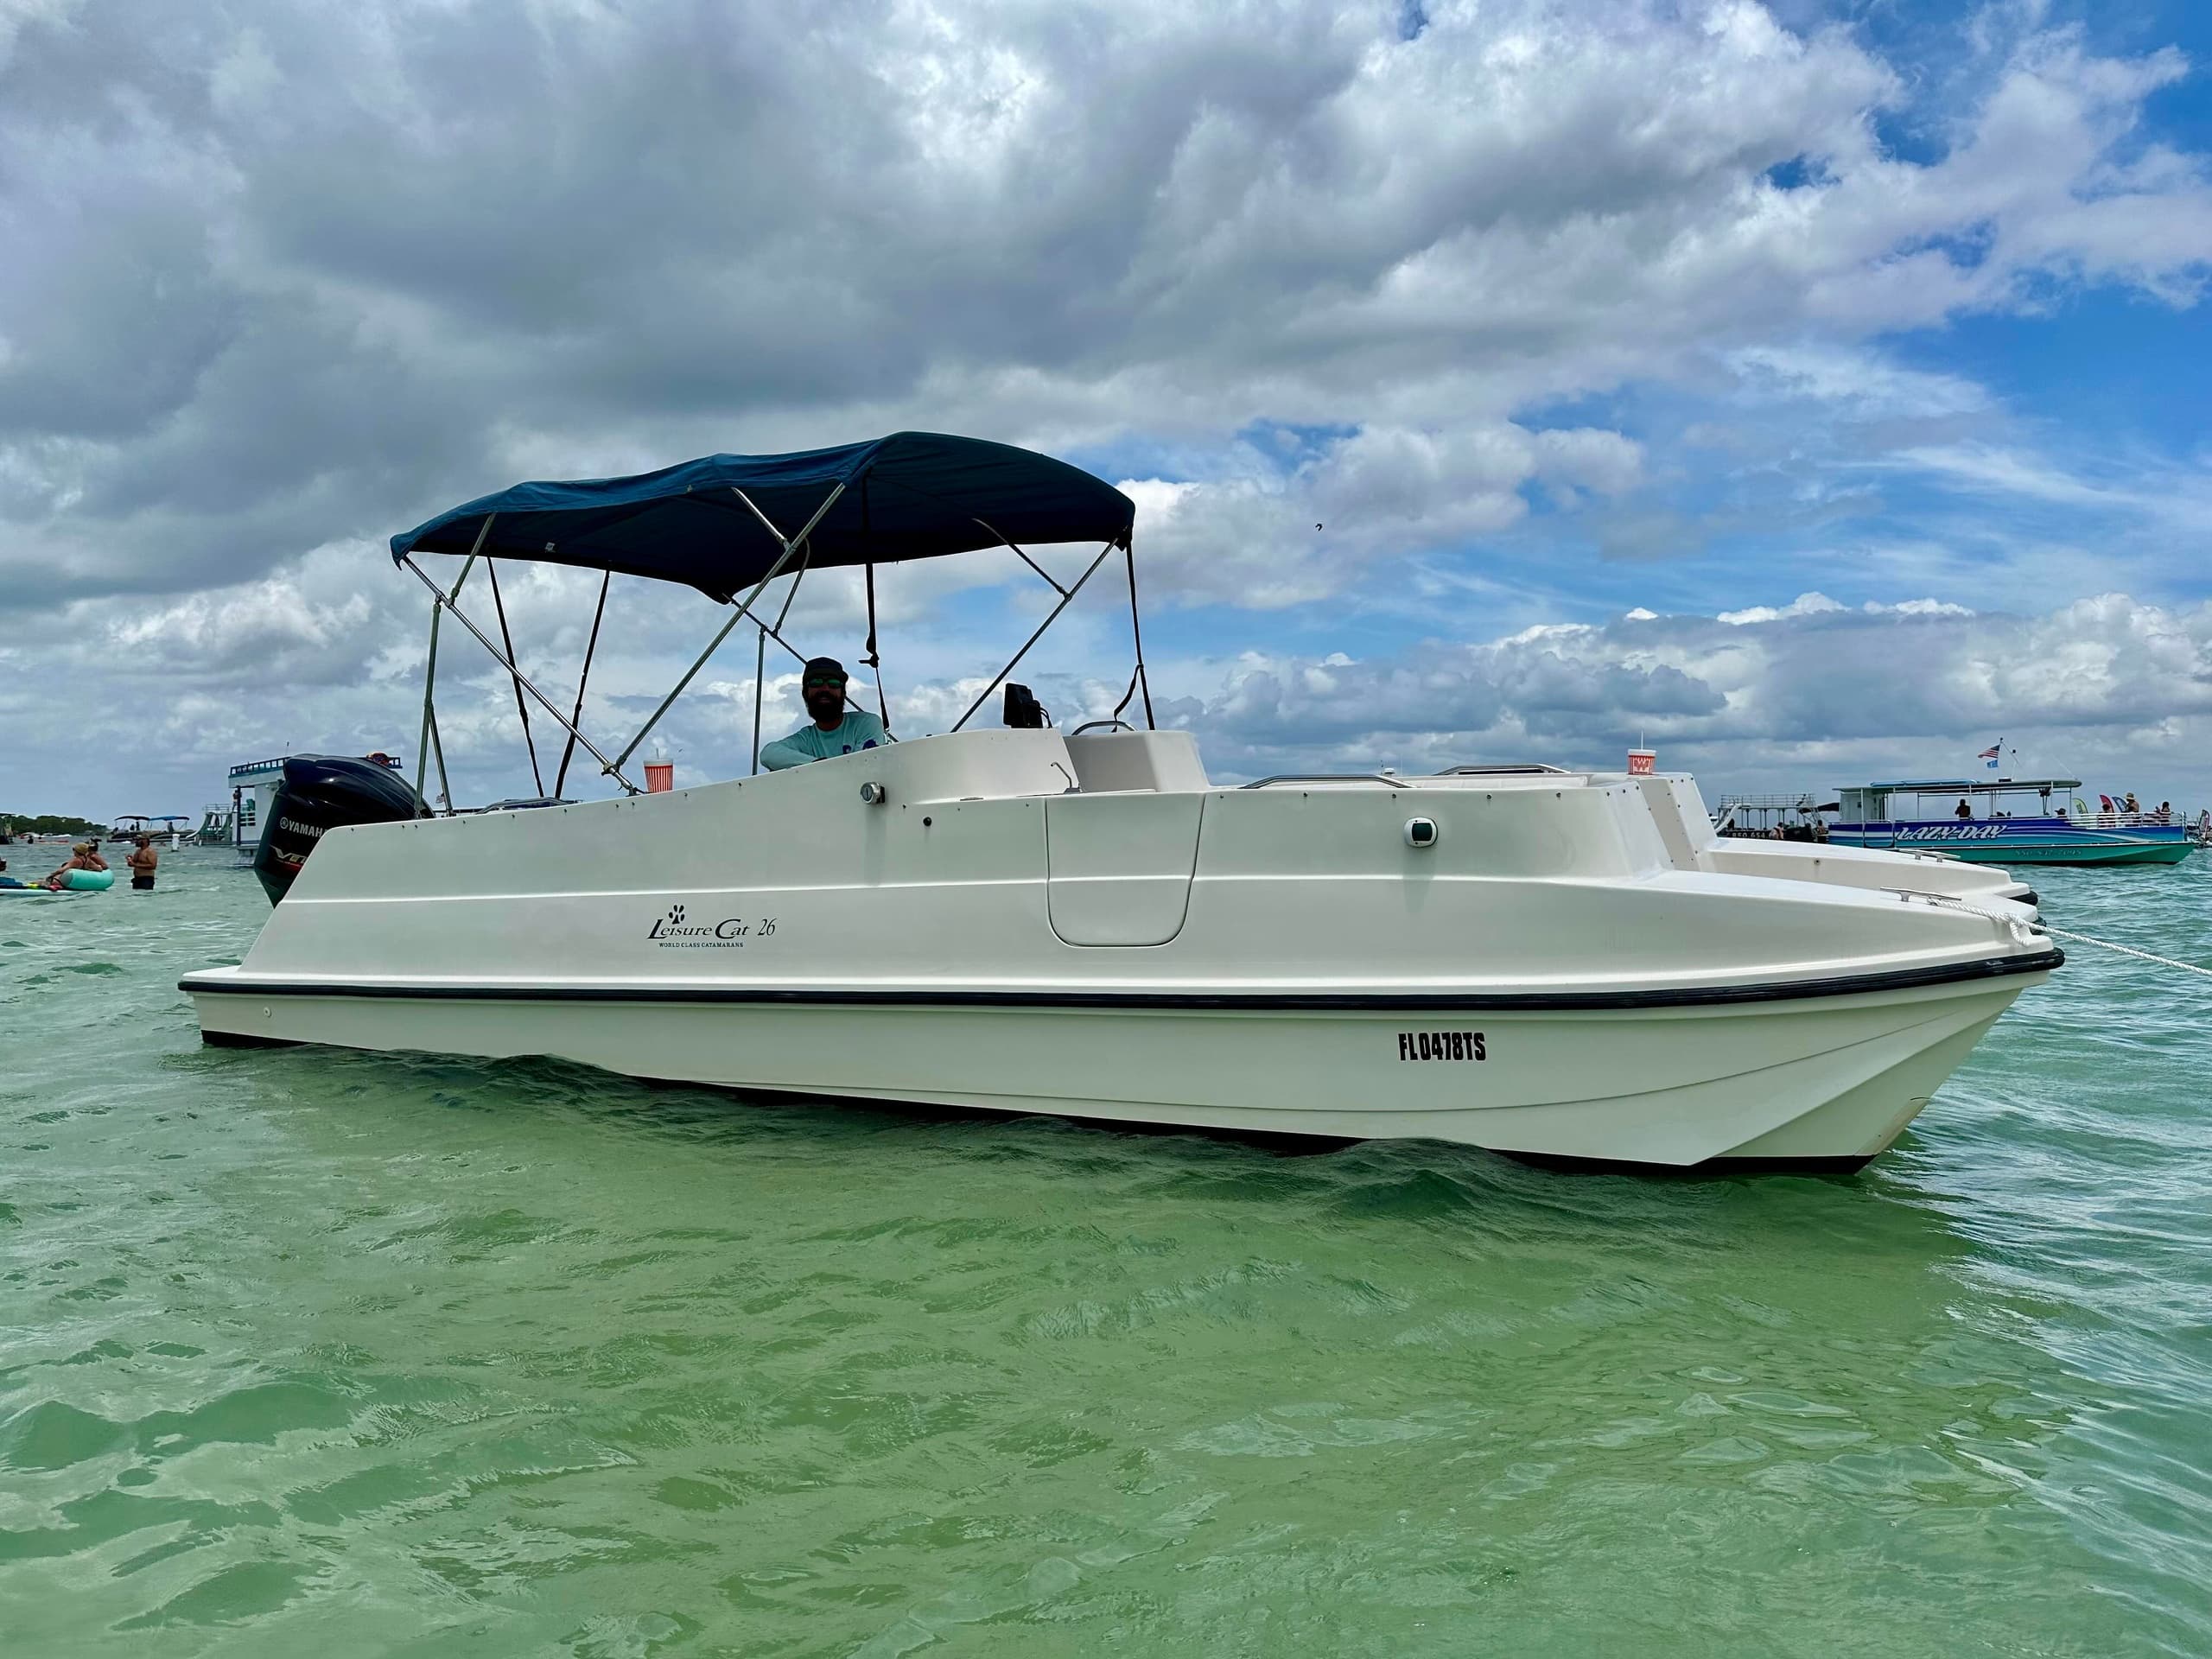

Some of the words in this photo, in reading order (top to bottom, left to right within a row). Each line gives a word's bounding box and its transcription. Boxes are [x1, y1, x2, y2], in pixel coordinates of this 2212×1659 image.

[289, 820, 329, 837] YAMAH
[1897, 825, 2007, 841] LAZY-DAY
[646, 918, 713, 939] Leisure
[715, 918, 750, 939] Cat
[757, 918, 777, 936] 26
